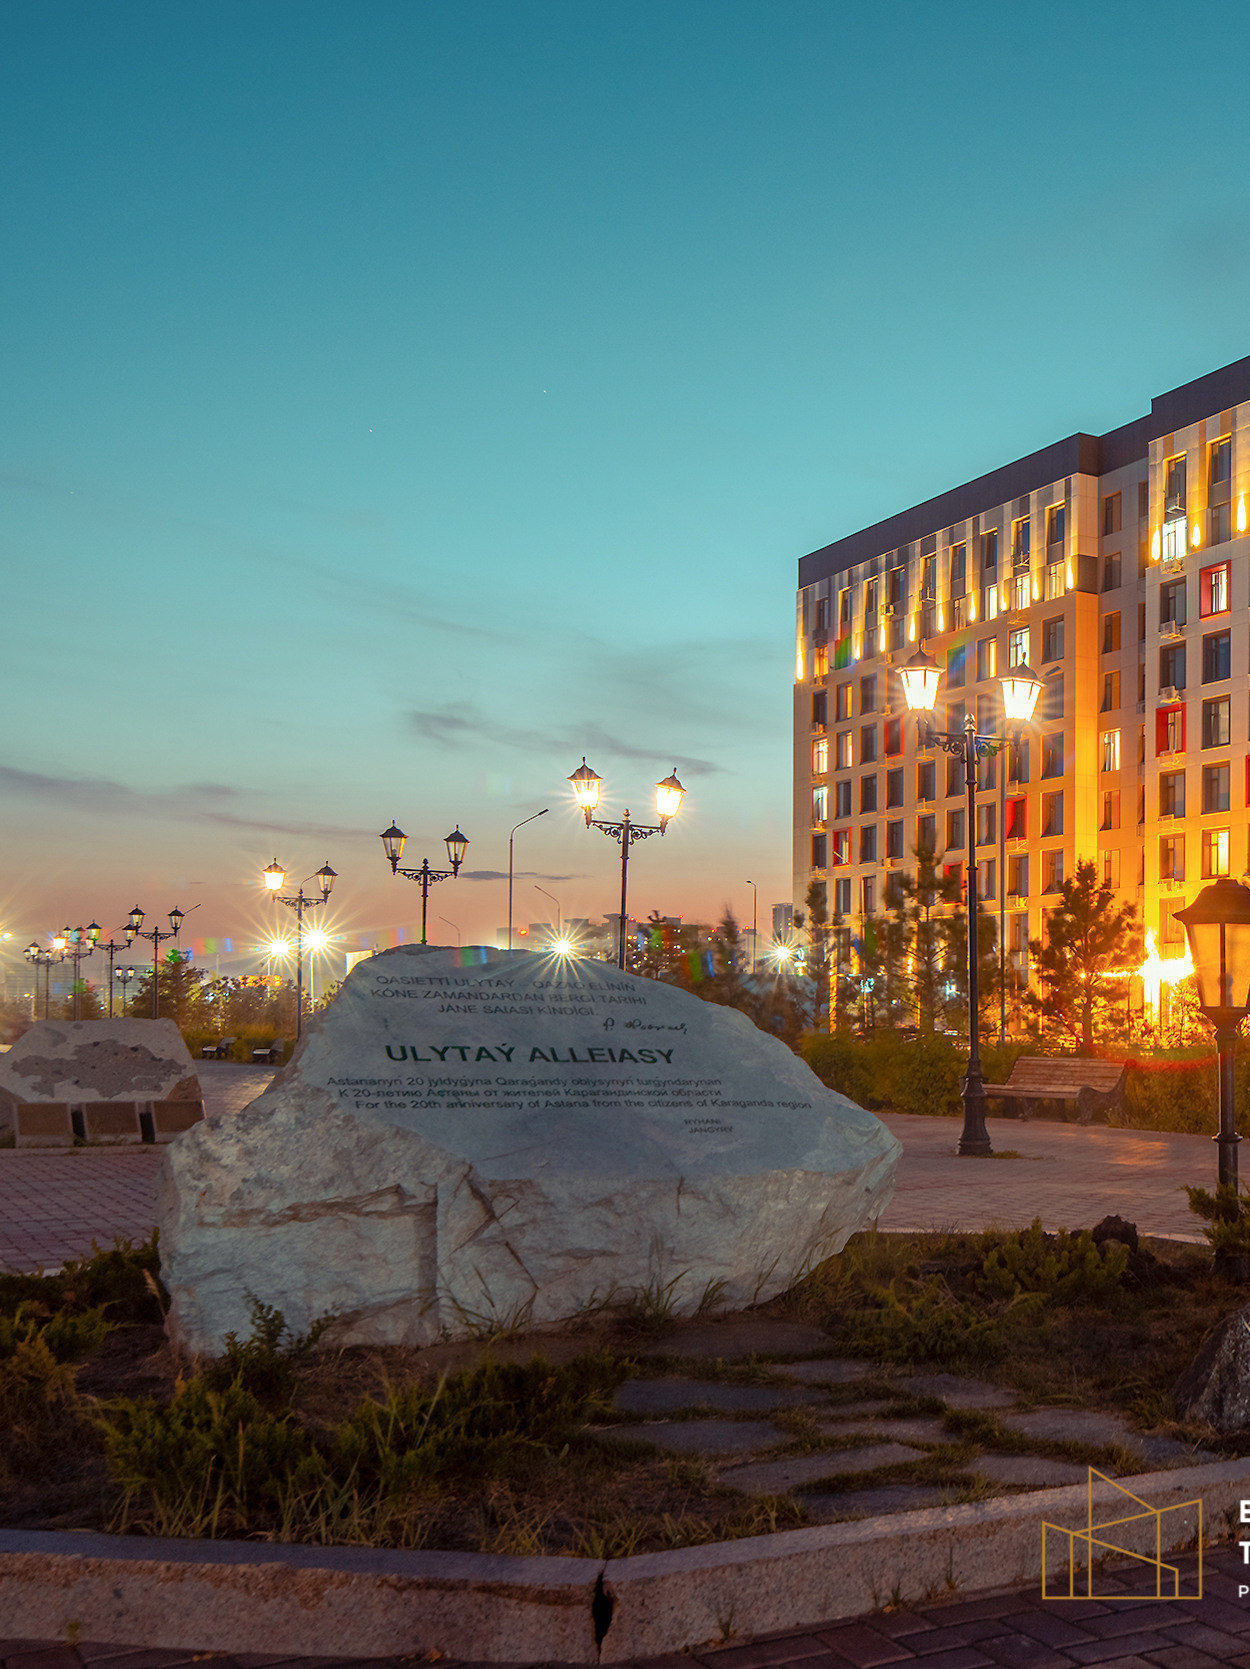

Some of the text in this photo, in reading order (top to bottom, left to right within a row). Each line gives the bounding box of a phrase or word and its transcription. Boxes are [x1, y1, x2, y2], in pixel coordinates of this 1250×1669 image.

[422, 990, 545, 1002] ZAMANDARDAN
[528, 1046, 675, 1064] ALLEIASY
[406, 1077, 425, 1086] 20
[427, 1088, 480, 1098] Астаны
[483, 1089, 498, 1097] от
[671, 1088, 722, 1097] области
[355, 1099, 812, 1111] For the 20th anniversary of Astana from the citizens of Karaganda region
